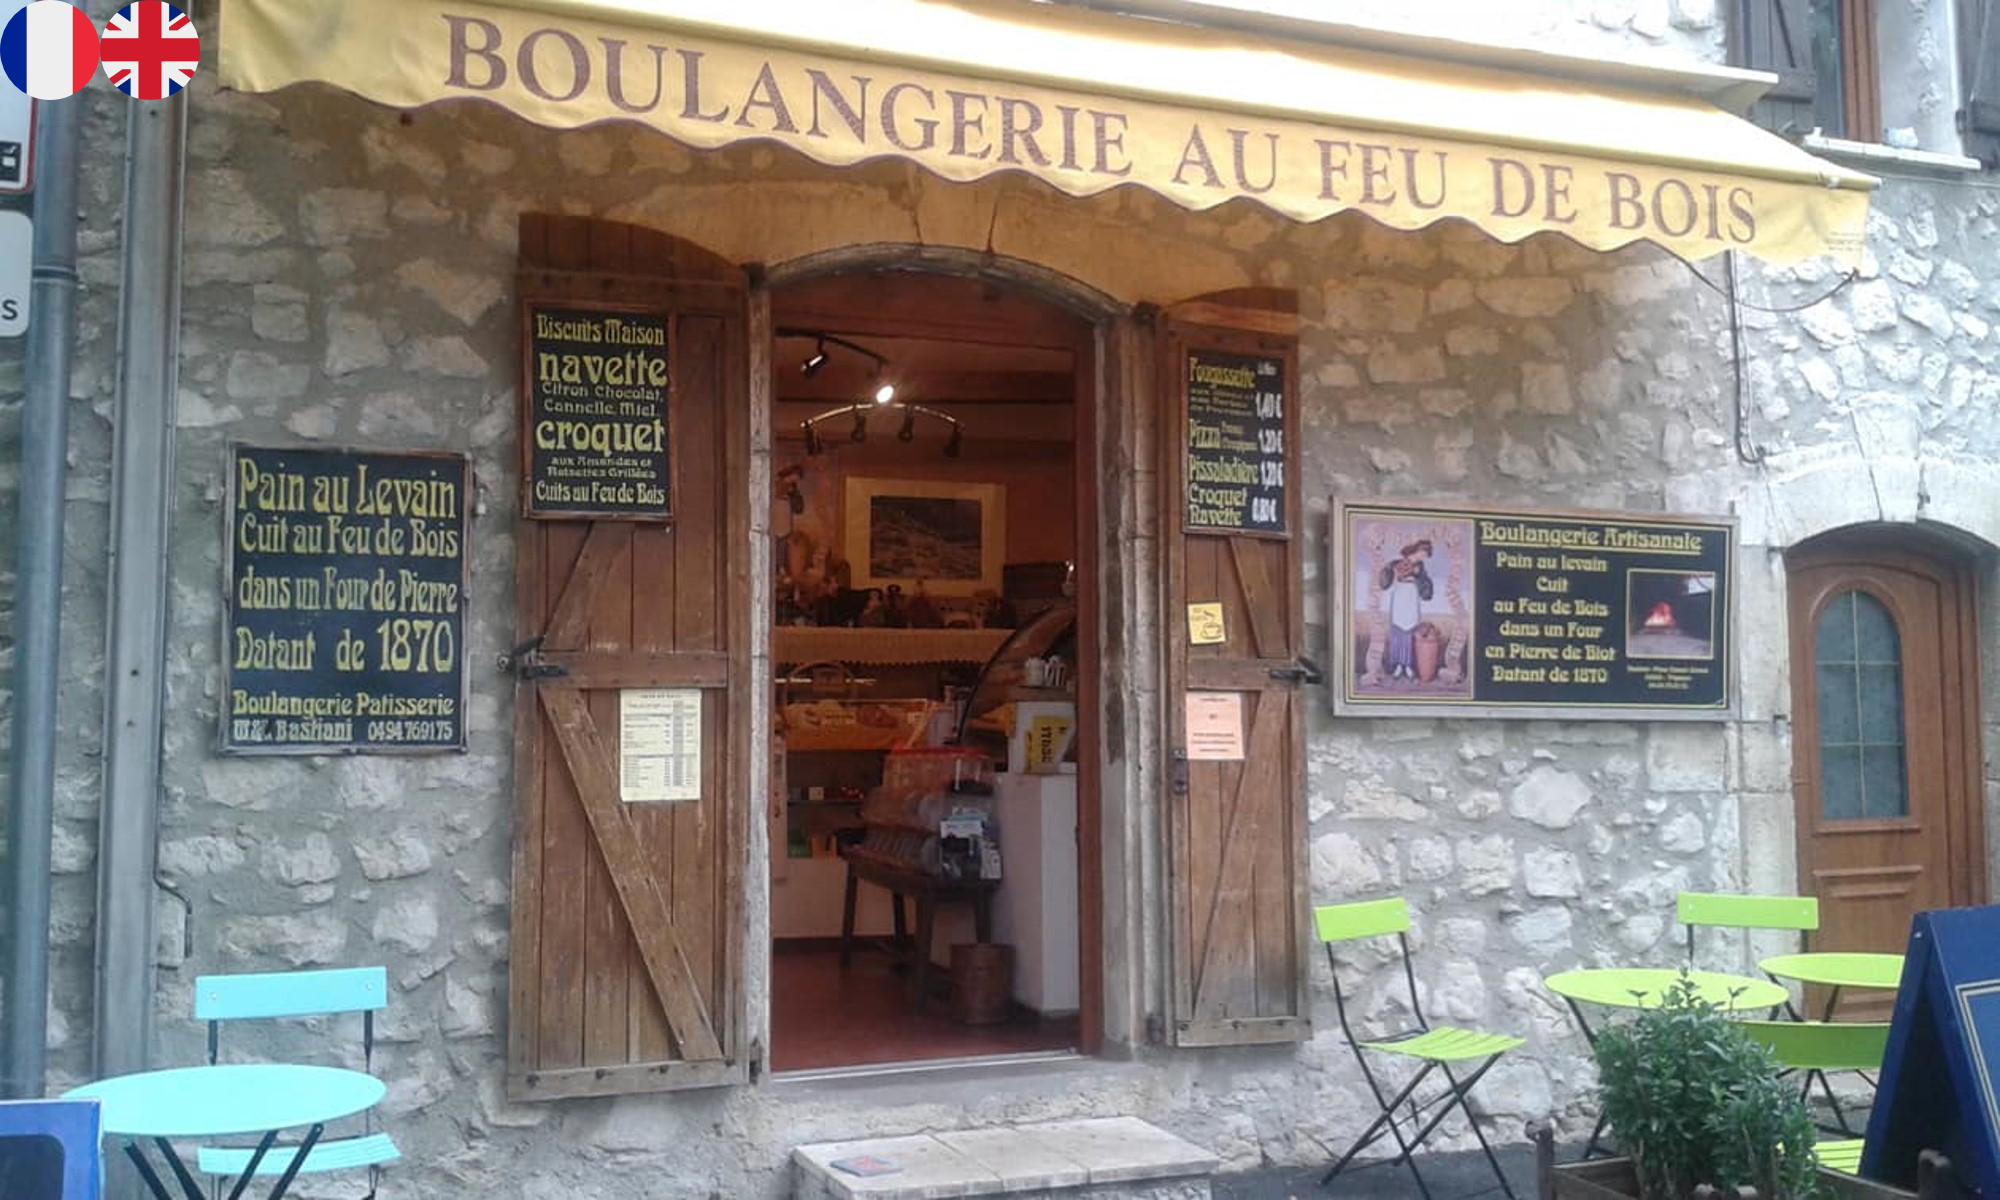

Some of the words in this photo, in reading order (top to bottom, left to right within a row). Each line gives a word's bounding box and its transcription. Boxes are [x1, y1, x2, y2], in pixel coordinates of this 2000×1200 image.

[442, 14, 1133, 177] BOULANGERIE
[1171, 123, 1280, 193] AU
[1314, 139, 1448, 209] FEU
[1487, 158, 1578, 223] DE
[1604, 171, 1756, 243] BOIS
[536, 314, 601, 342] Biscuits
[604, 319, 665, 346] Maison
[539, 351, 668, 387] navette
[542, 381, 589, 397] Citron
[544, 400, 616, 415] Cannelle
[536, 419, 665, 457] croquet
[1189, 419, 1221, 449] Pizza
[238, 458, 305, 511] Pain
[313, 475, 349, 513] au
[355, 464, 456, 518] Levain
[536, 480, 571, 502] Cuits
[573, 485, 590, 503] au
[591, 481, 617, 503] Feu
[617, 482, 635, 503] de
[636, 482, 665, 505] Bois
[1189, 482, 1248, 508] Croquet
[240, 513, 289, 553] Cuit
[293, 525, 322, 554] au
[327, 515, 370, 555] Feu
[375, 519, 404, 556] de
[409, 519, 458, 558] Bois
[1479, 521, 1598, 547] Boulangerie
[1603, 527, 1702, 551] Artisanale
[1496, 551, 1532, 568] Pain
[1537, 557, 1557, 570] au
[1561, 554, 1607, 572] levain
[239, 566, 290, 609] dans
[296, 577, 320, 610] un
[324, 566, 368, 611] Four
[370, 568, 396, 612] de
[400, 569, 457, 614] Pierre
[1536, 576, 1569, 592] Cuit
[1494, 601, 1514, 614] au
[1518, 598, 1547, 615] Feu
[1550, 599, 1571, 615] de
[1575, 600, 1609, 617] Bois
[1499, 620, 1539, 636] dans
[1544, 625, 1564, 638] un
[1567, 622, 1604, 639] Four
[235, 626, 316, 671] Datant
[336, 629, 365, 671] de
[377, 619, 454, 672] 1870
[1485, 646, 1505, 659] en
[1510, 642, 1558, 660] Pierre
[1562, 645, 1581, 660] de
[1492, 665, 1545, 682] Datant
[1549, 667, 1569, 682] de
[1574, 667, 1607, 683] 1870
[232, 689, 352, 717] Boulangerie
[355, 692, 454, 715] Patisserie
[276, 718, 353, 742] Bastiani
